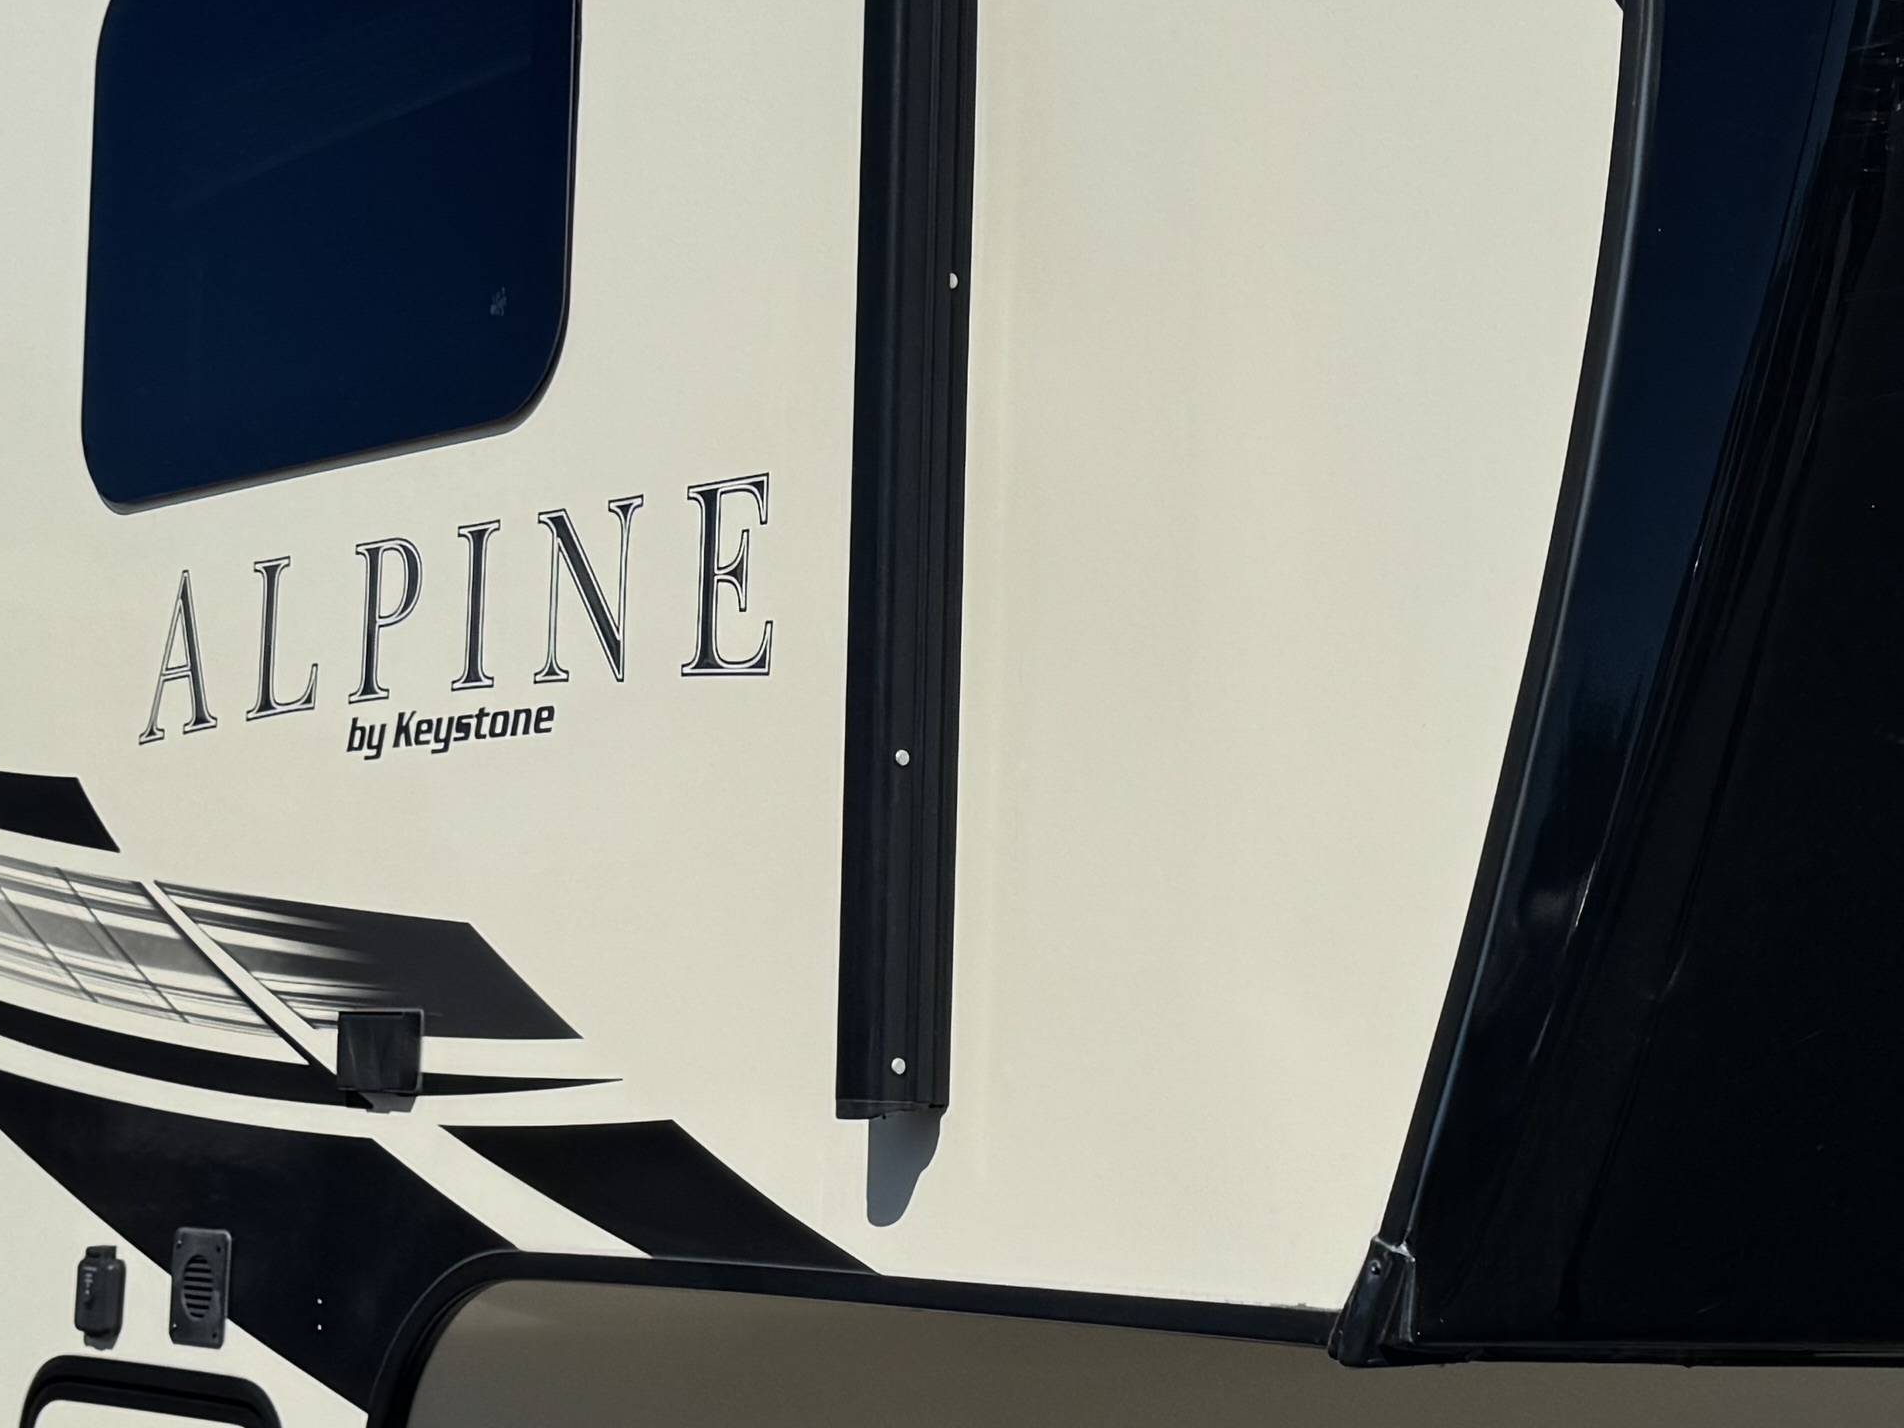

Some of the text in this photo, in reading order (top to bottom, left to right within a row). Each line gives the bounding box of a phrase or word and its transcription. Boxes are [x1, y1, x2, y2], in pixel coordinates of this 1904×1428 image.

[138, 472, 774, 745] ALPINE
[346, 703, 555, 760] by Keystone
